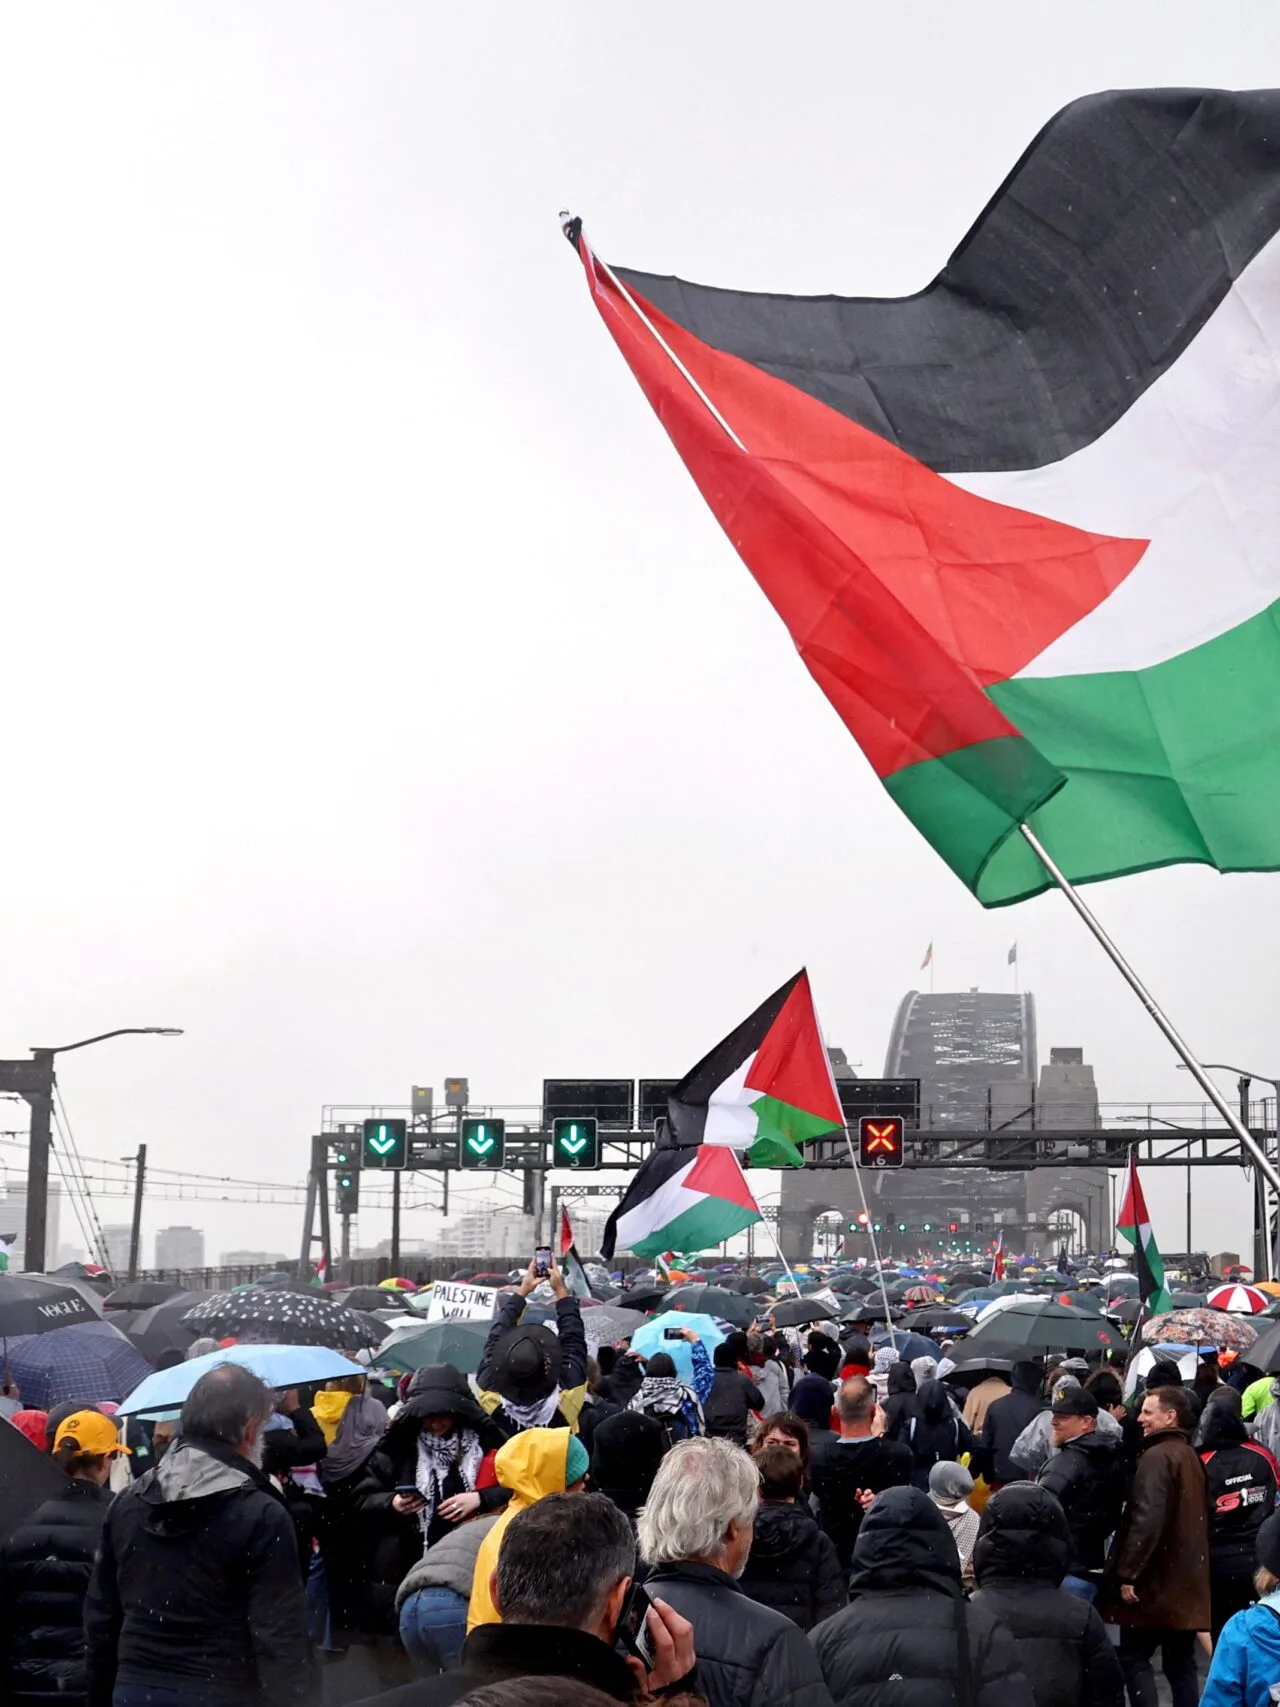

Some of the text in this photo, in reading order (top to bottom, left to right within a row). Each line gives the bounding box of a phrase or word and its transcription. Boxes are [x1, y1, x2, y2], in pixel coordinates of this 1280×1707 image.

[477, 1155, 488, 1167] 2
[570, 1155, 580, 1167] 3
[876, 1154, 887, 1166] 6
[433, 1284, 494, 1307] PALESTINE
[1225, 1473, 1254, 1486] OFFICIAL
